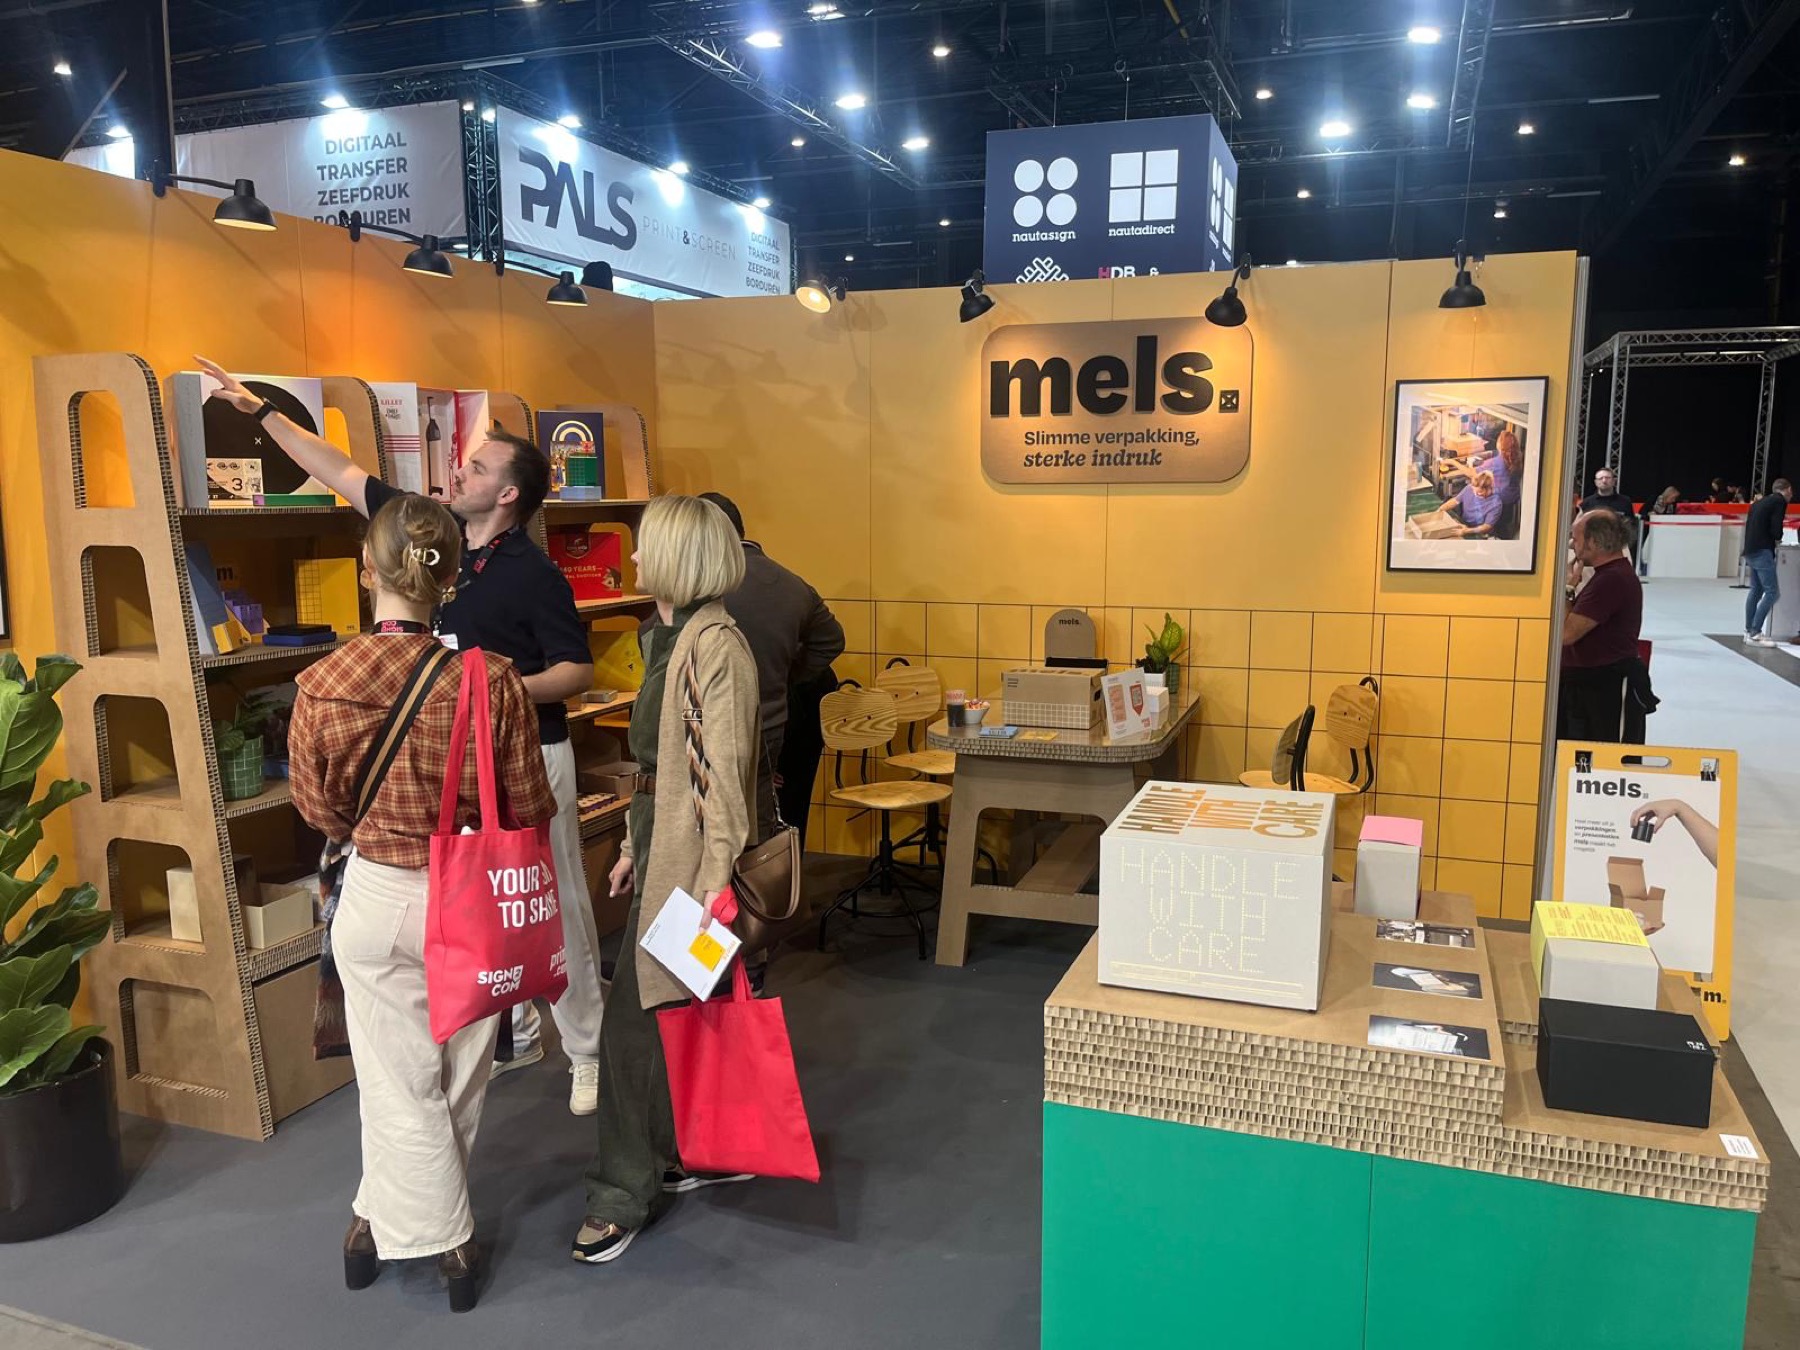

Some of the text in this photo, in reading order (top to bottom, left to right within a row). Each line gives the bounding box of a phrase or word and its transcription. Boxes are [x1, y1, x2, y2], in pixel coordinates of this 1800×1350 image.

[325, 132, 407, 154] DIGITAAL
[317, 157, 408, 180] TRANSFER
[317, 183, 411, 206] ZEEFDRUK
[519, 146, 637, 251] PALS
[751, 231, 780, 251] DIGITAAL
[1012, 224, 1175, 242] nautasign nautadirect
[748, 246, 781, 265] TRANSFER
[747, 261, 781, 280] ZEEFDRUK
[1024, 428, 1200, 446] Slimme verpakking,
[1024, 449, 1162, 467] sterke indruk
[232, 477, 243, 491] 3
[487, 865, 540, 897] YOUR
[1120, 846, 1300, 899] HANDLE
[497, 900, 525, 929] TO
[1149, 887, 1267, 937] WITH
[1149, 926, 1266, 974] CARE
[491, 980, 521, 997] COM
